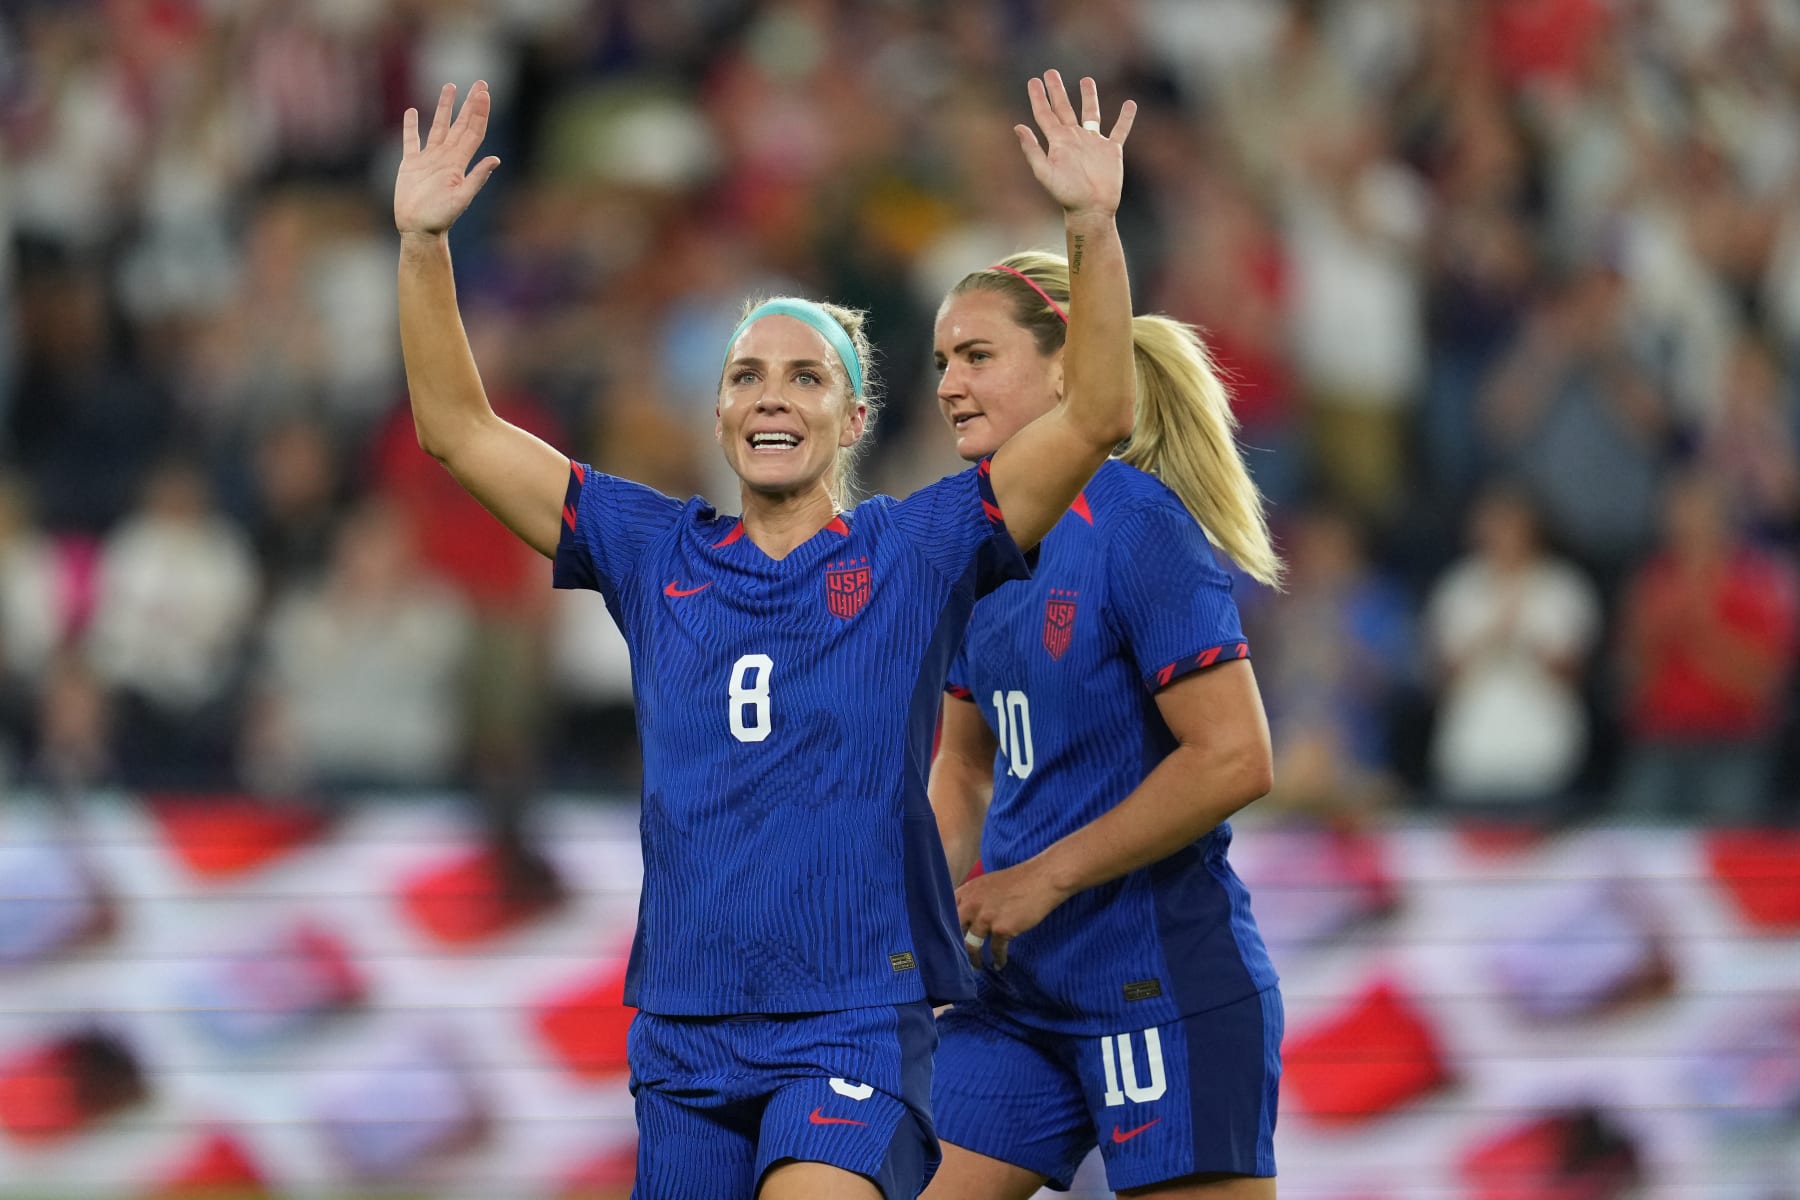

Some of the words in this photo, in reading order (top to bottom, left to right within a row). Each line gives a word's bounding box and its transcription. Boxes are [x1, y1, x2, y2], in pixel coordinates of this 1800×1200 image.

[829, 571, 868, 593] USA
[728, 653, 775, 743] 8
[992, 690, 1034, 780] 10
[1101, 1026, 1168, 1107] 10
